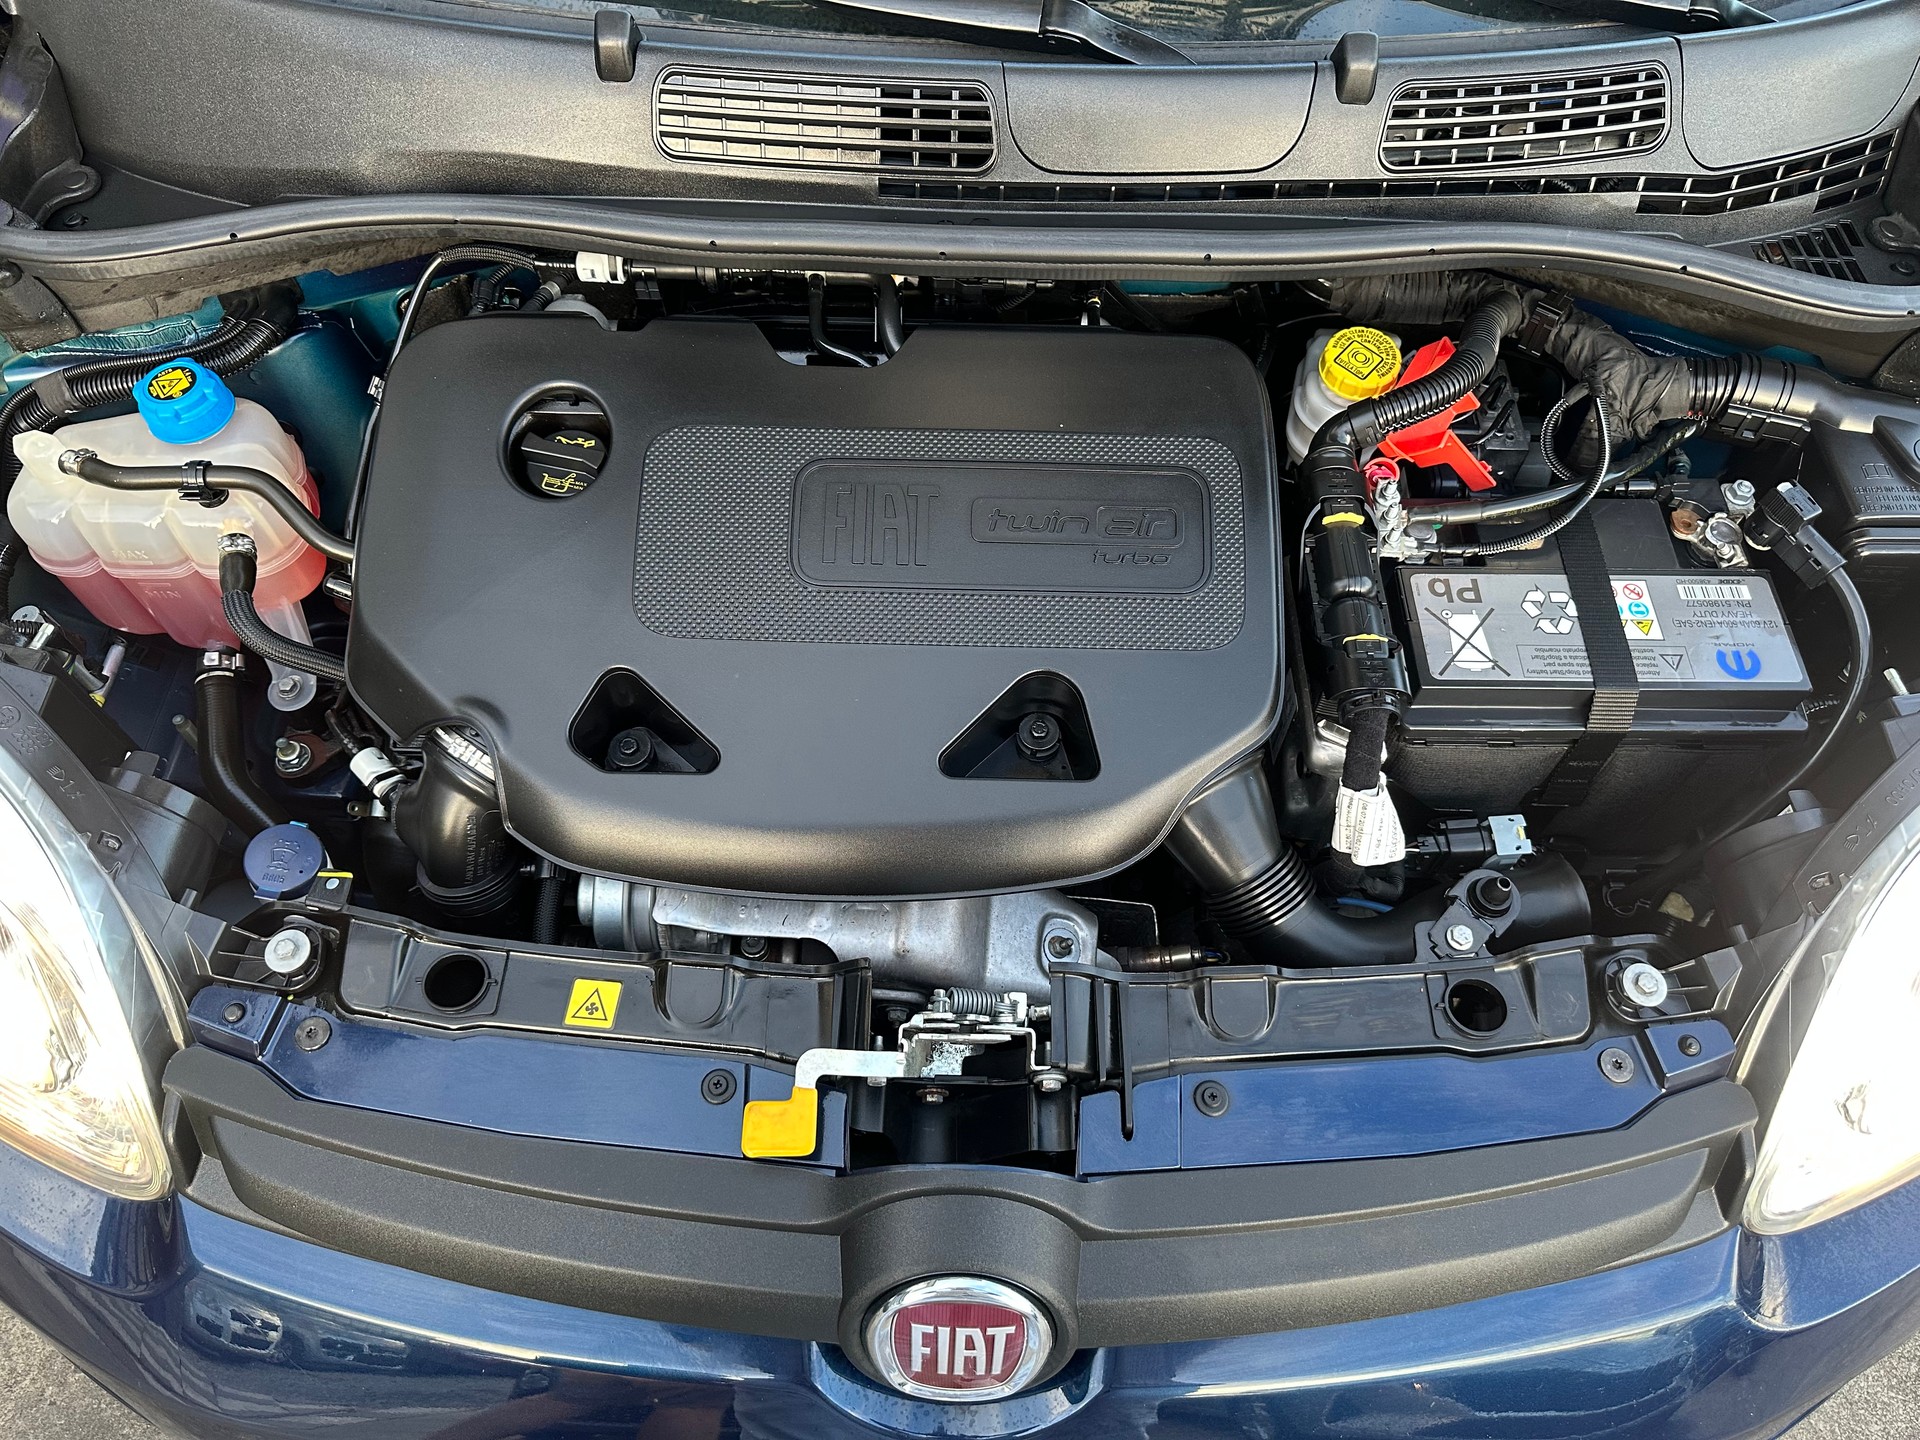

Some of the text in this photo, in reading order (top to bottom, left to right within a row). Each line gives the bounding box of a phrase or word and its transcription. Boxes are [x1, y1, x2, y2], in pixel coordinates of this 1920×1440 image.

[822, 482, 941, 567] FIAT
[988, 507, 1168, 537] twin air
[1092, 549, 1172, 566] turbo
[1427, 578, 1483, 604] Pb
[1686, 600, 1731, 608] 51980577
[1692, 610, 1752, 618] HEAVY DUTY
[1672, 618, 1716, 628] (EN2-SAE)
[1740, 619, 1761, 628] 60Ah
[1763, 620, 1778, 628] 12V
[910, 1321, 1016, 1376] FIAT
